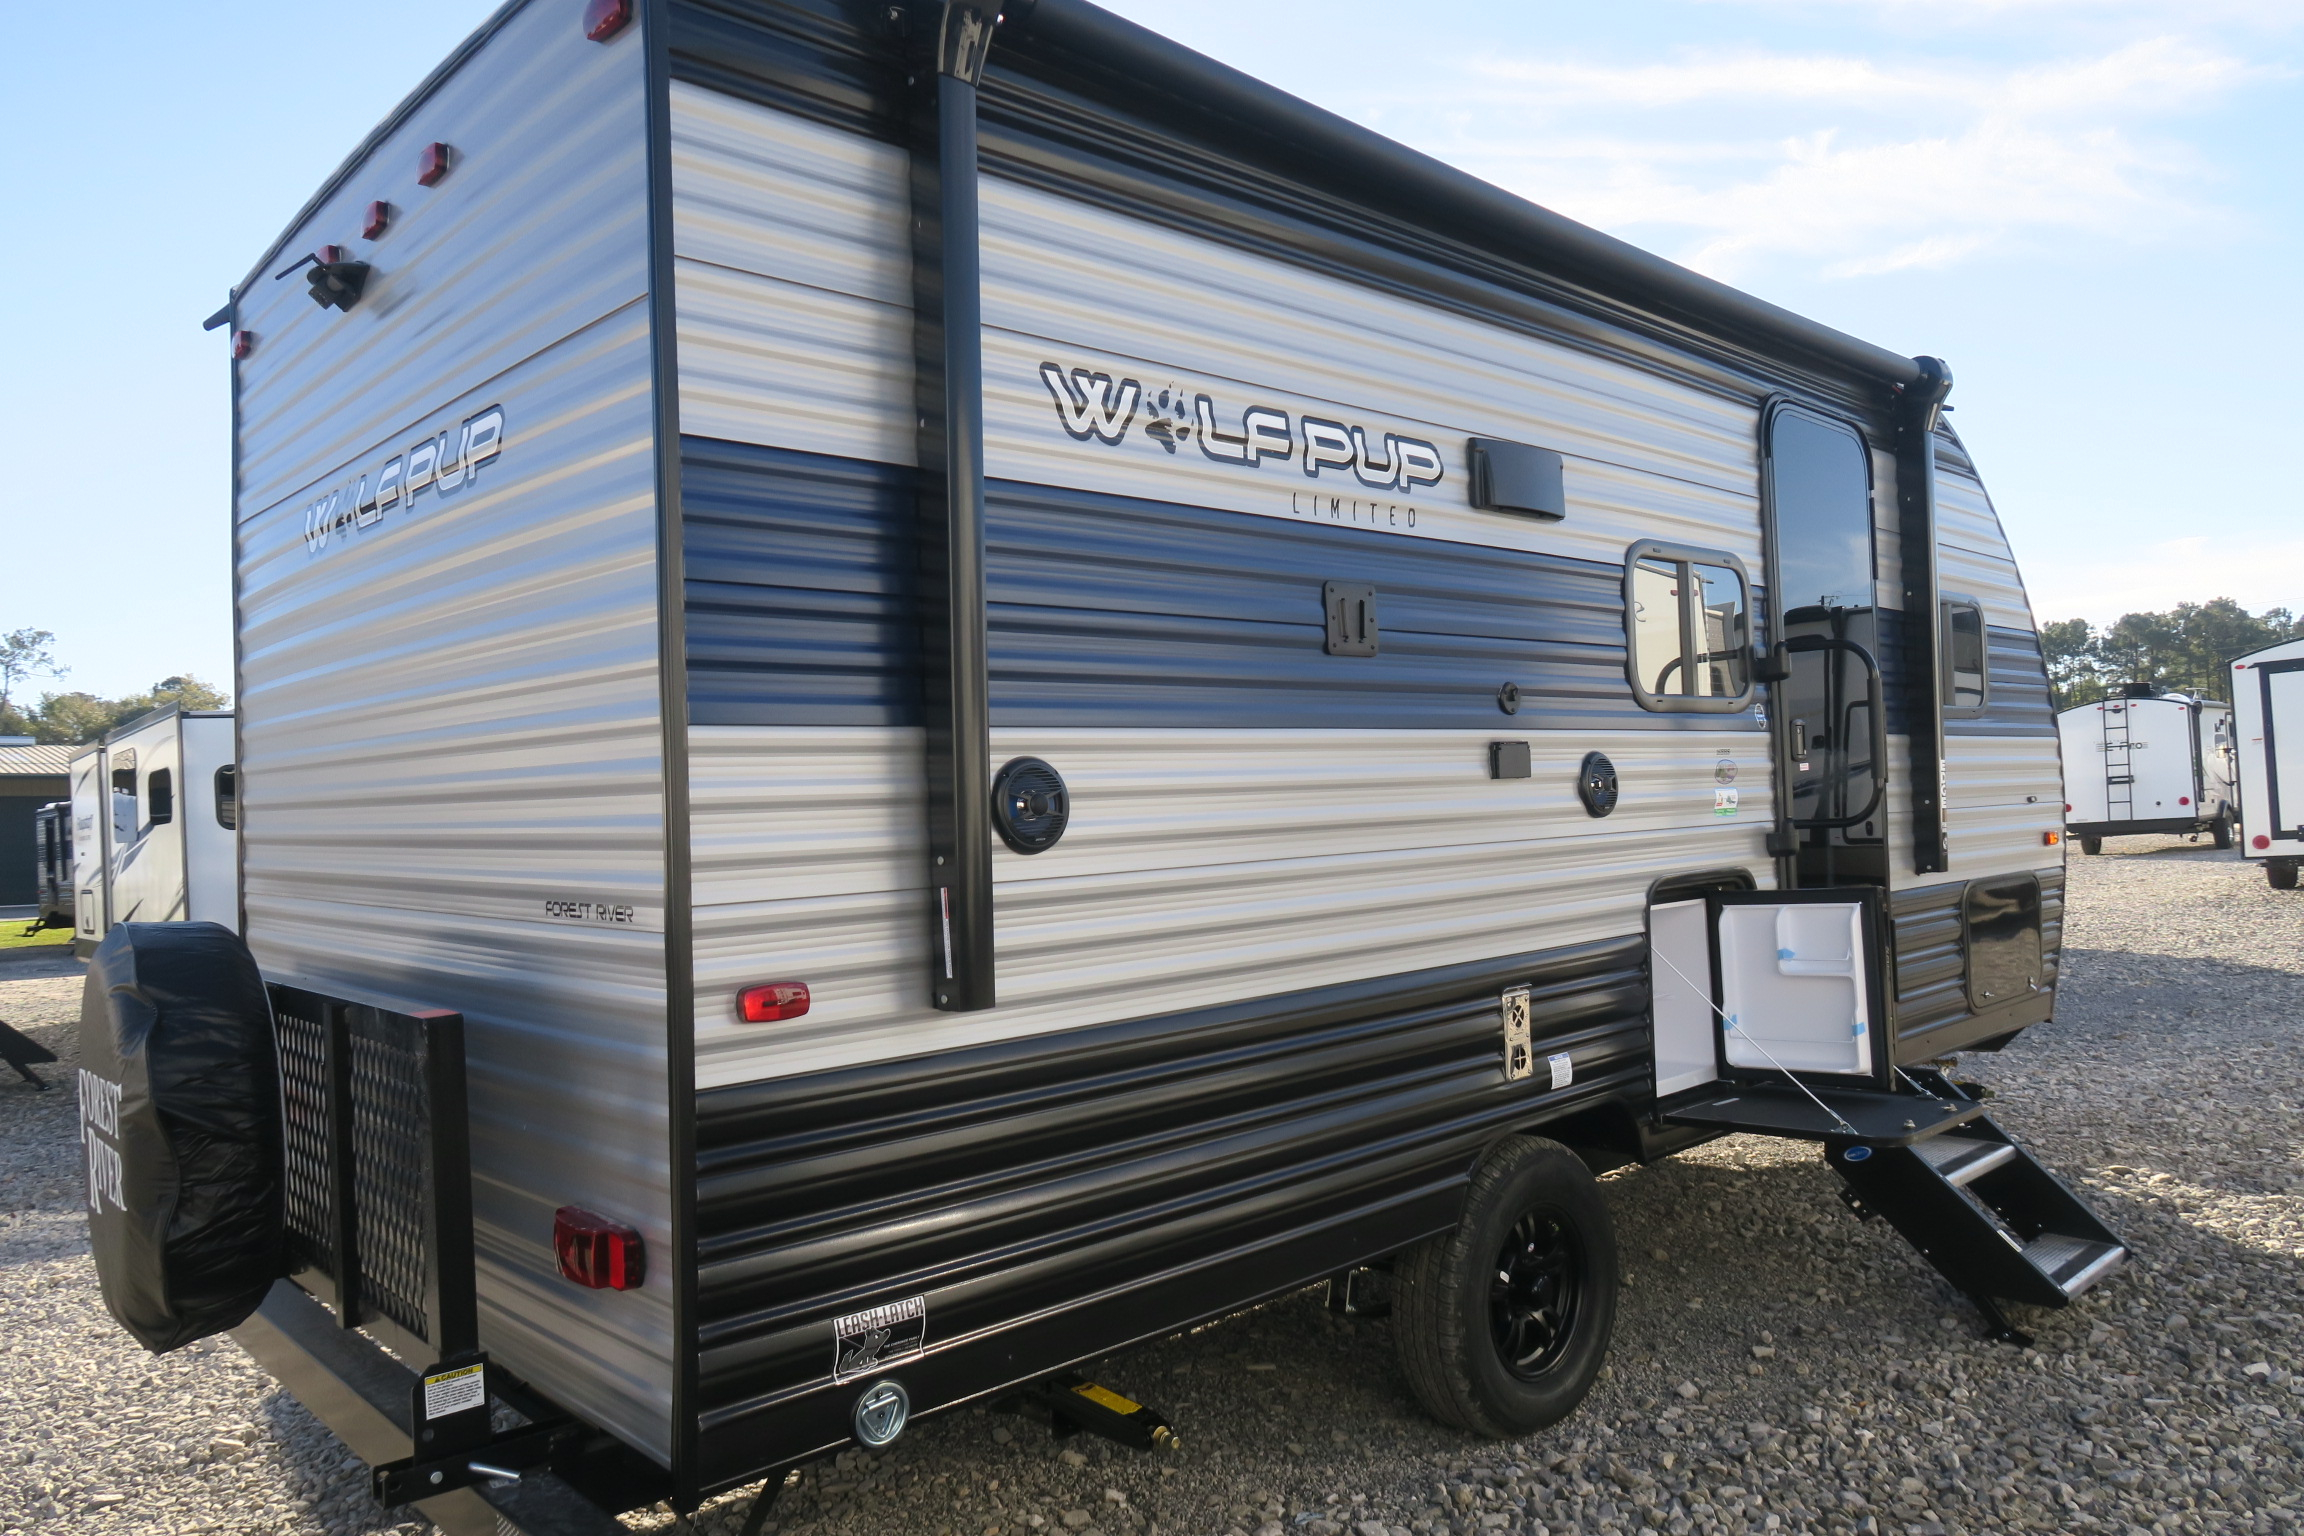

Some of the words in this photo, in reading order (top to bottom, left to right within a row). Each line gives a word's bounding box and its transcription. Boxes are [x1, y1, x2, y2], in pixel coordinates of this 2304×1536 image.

[405, 403, 506, 514] PUP
[1301, 415, 1444, 494] PUP
[1293, 492, 1416, 528] LIMITED
[545, 901, 591, 919] FOREST
[596, 904, 634, 922] RIVER
[79, 1068, 122, 1144] FOREST
[87, 1127, 127, 1214] RIVER
[441, 1367, 474, 1381] CAUTION
